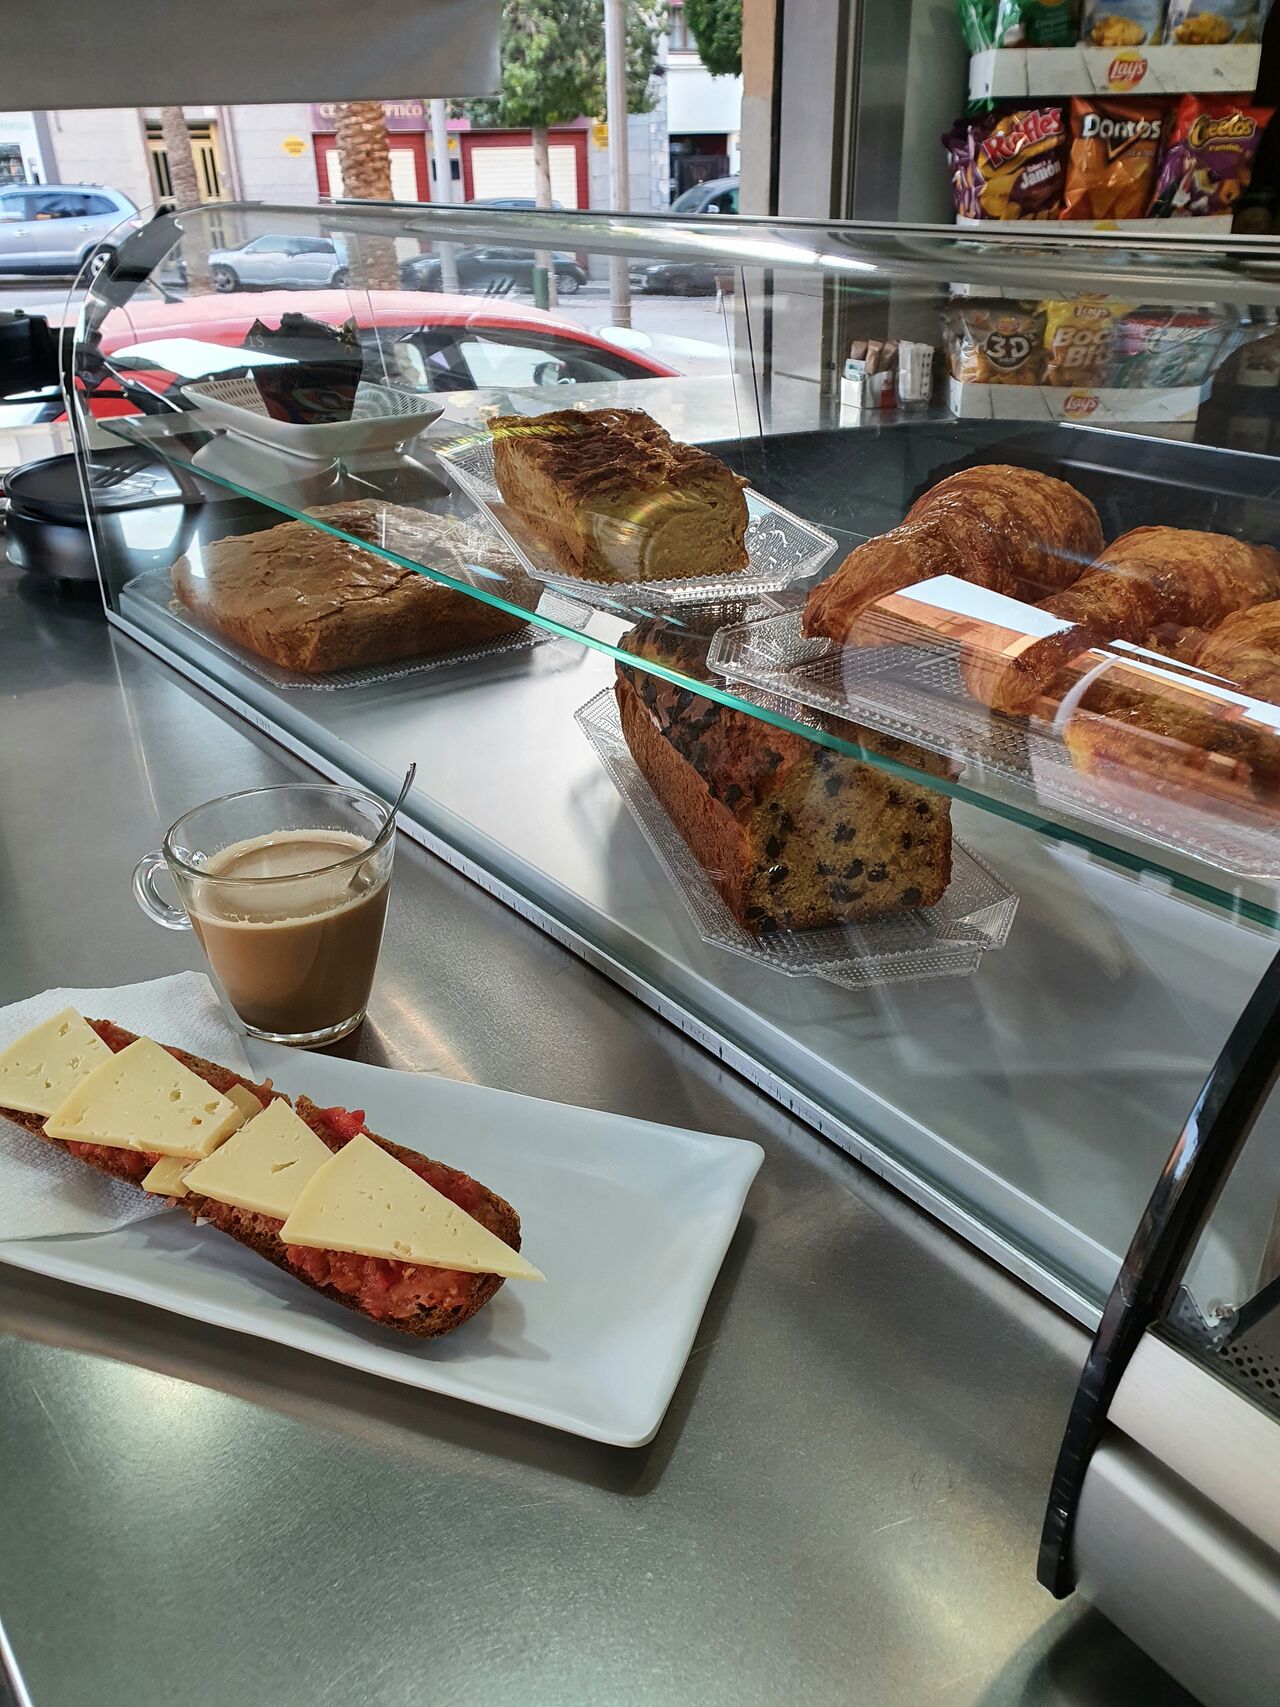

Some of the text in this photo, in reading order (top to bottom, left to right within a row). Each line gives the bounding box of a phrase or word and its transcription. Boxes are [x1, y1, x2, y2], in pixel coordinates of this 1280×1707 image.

[1111, 58, 1148, 80] Lay's
[1081, 113, 1162, 139] Doritos
[1064, 396, 1099, 412] Lay's
